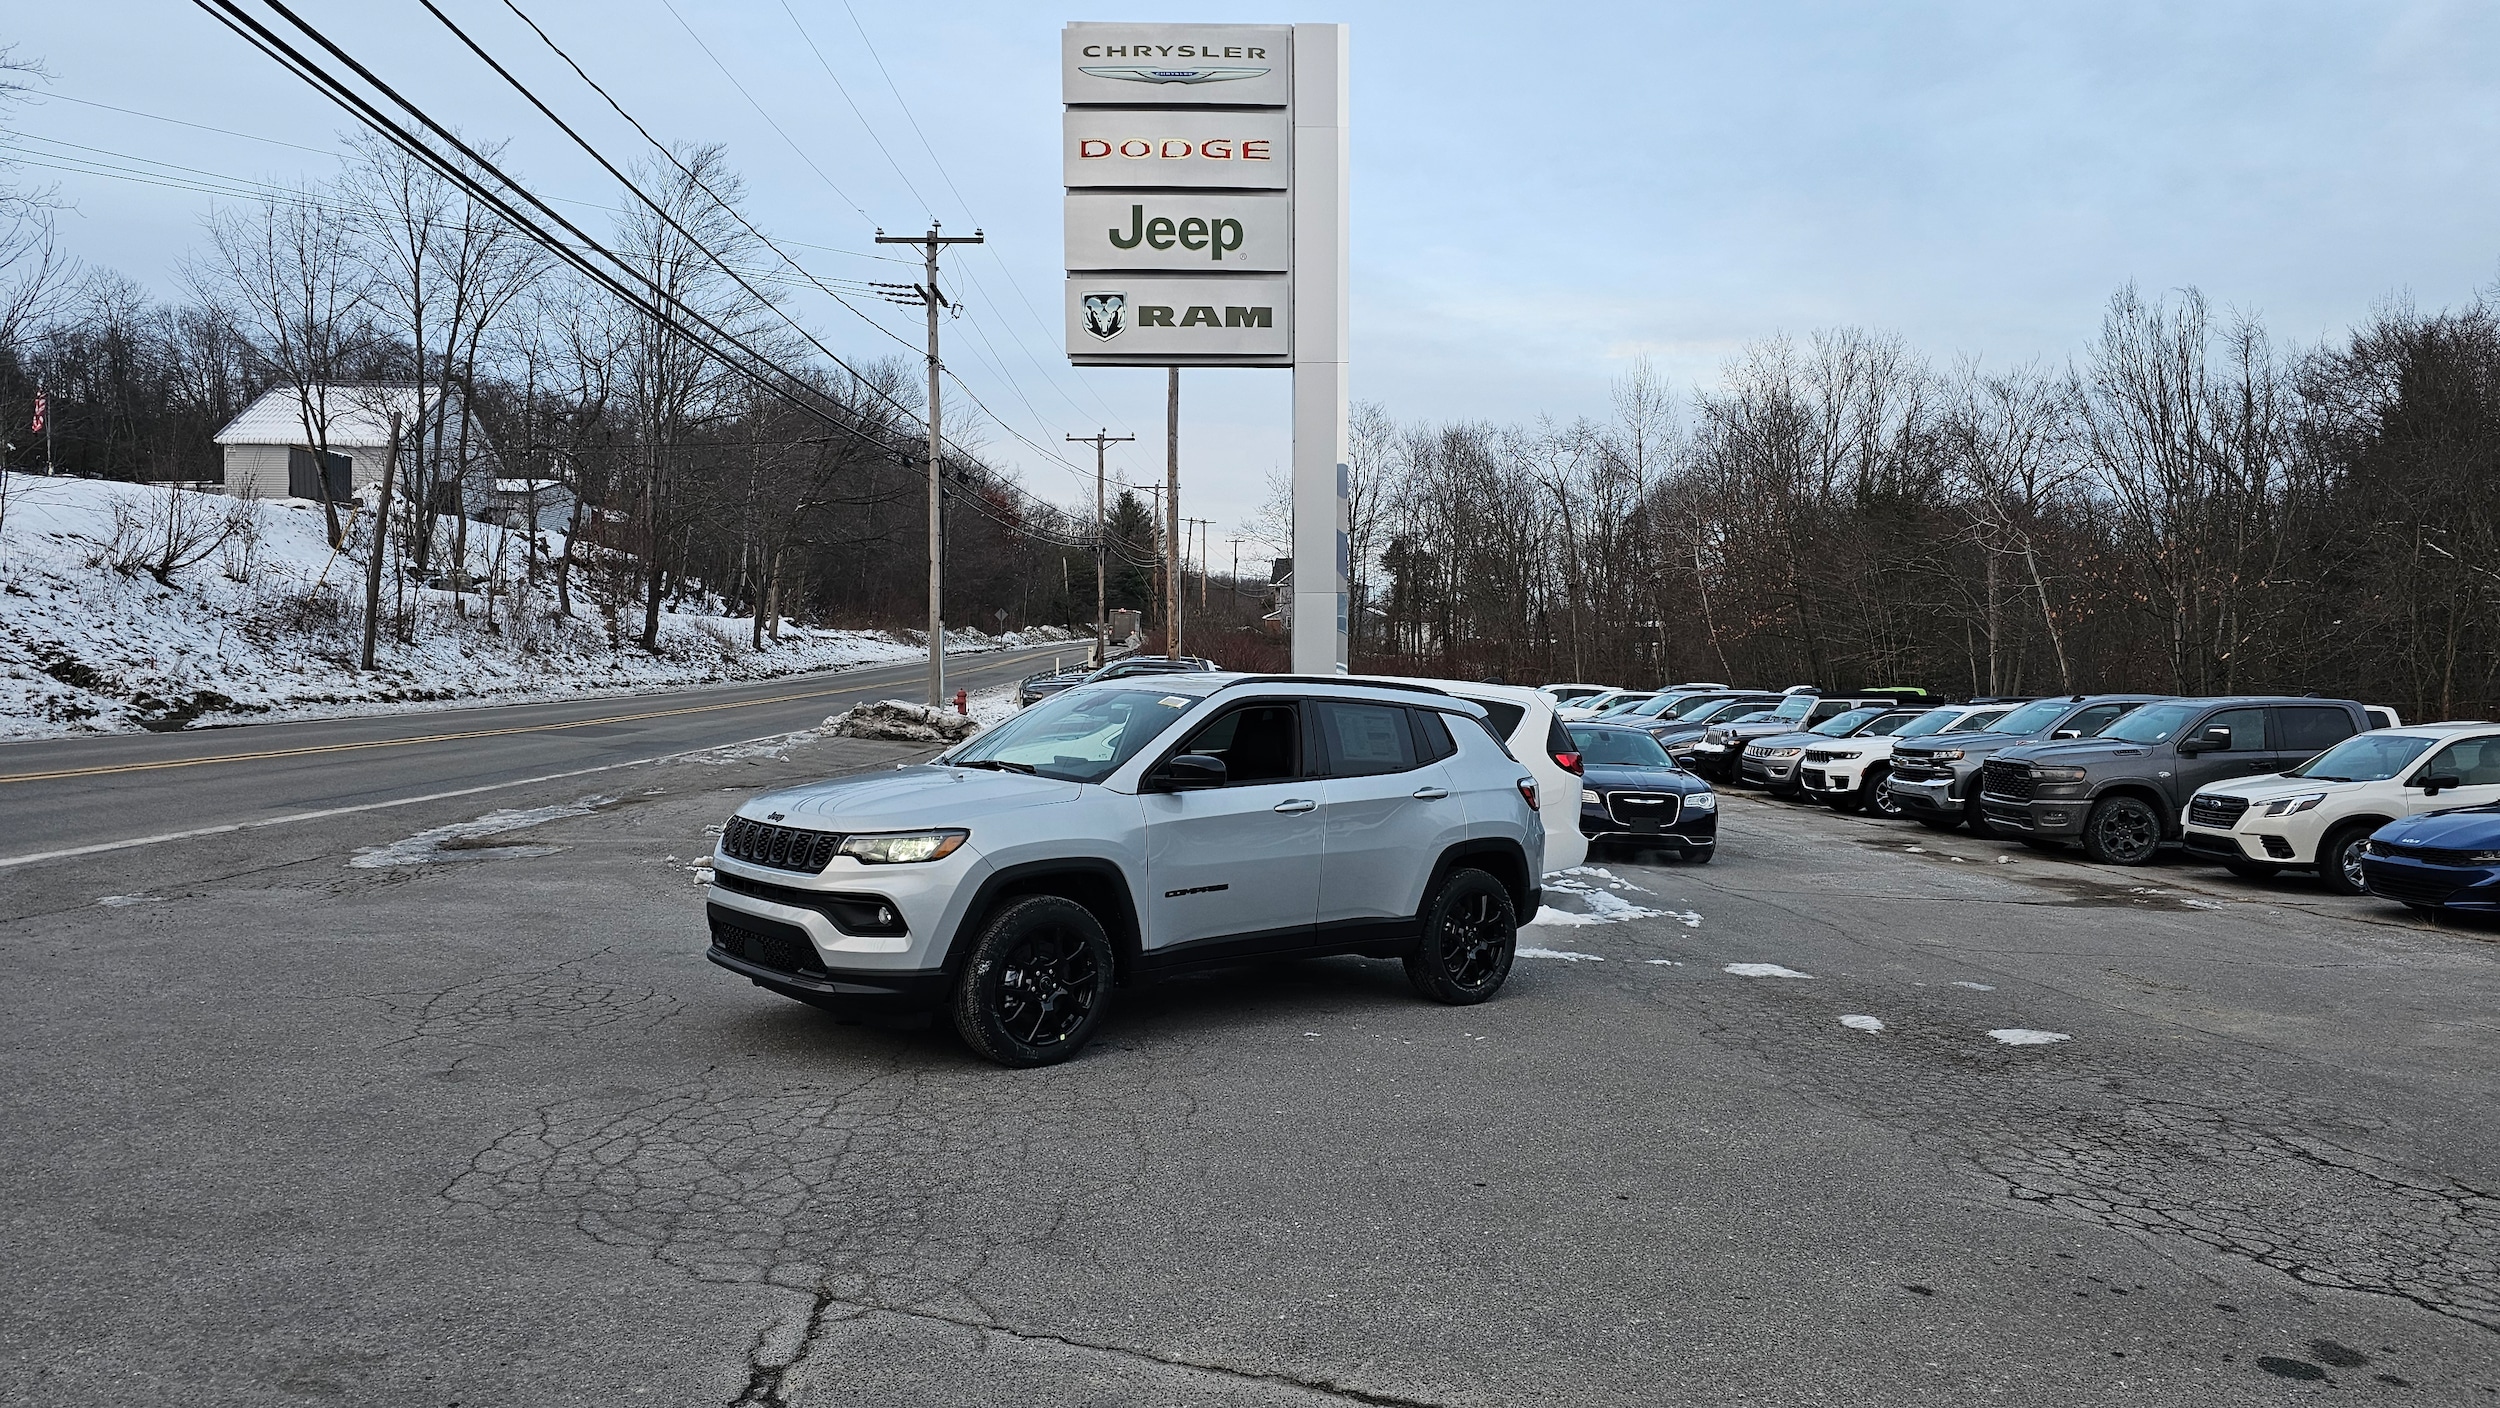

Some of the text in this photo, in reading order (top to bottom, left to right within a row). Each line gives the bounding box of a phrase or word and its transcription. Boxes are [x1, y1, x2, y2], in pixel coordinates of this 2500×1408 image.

[1082, 45, 1266, 59] CHRYSLER
[1079, 138, 1273, 161] DODGE
[1109, 204, 1244, 261] Jeep
[1138, 305, 1273, 328] RAM
[767, 811, 785, 823] Jeep
[1165, 883, 1229, 898] COMPASS
